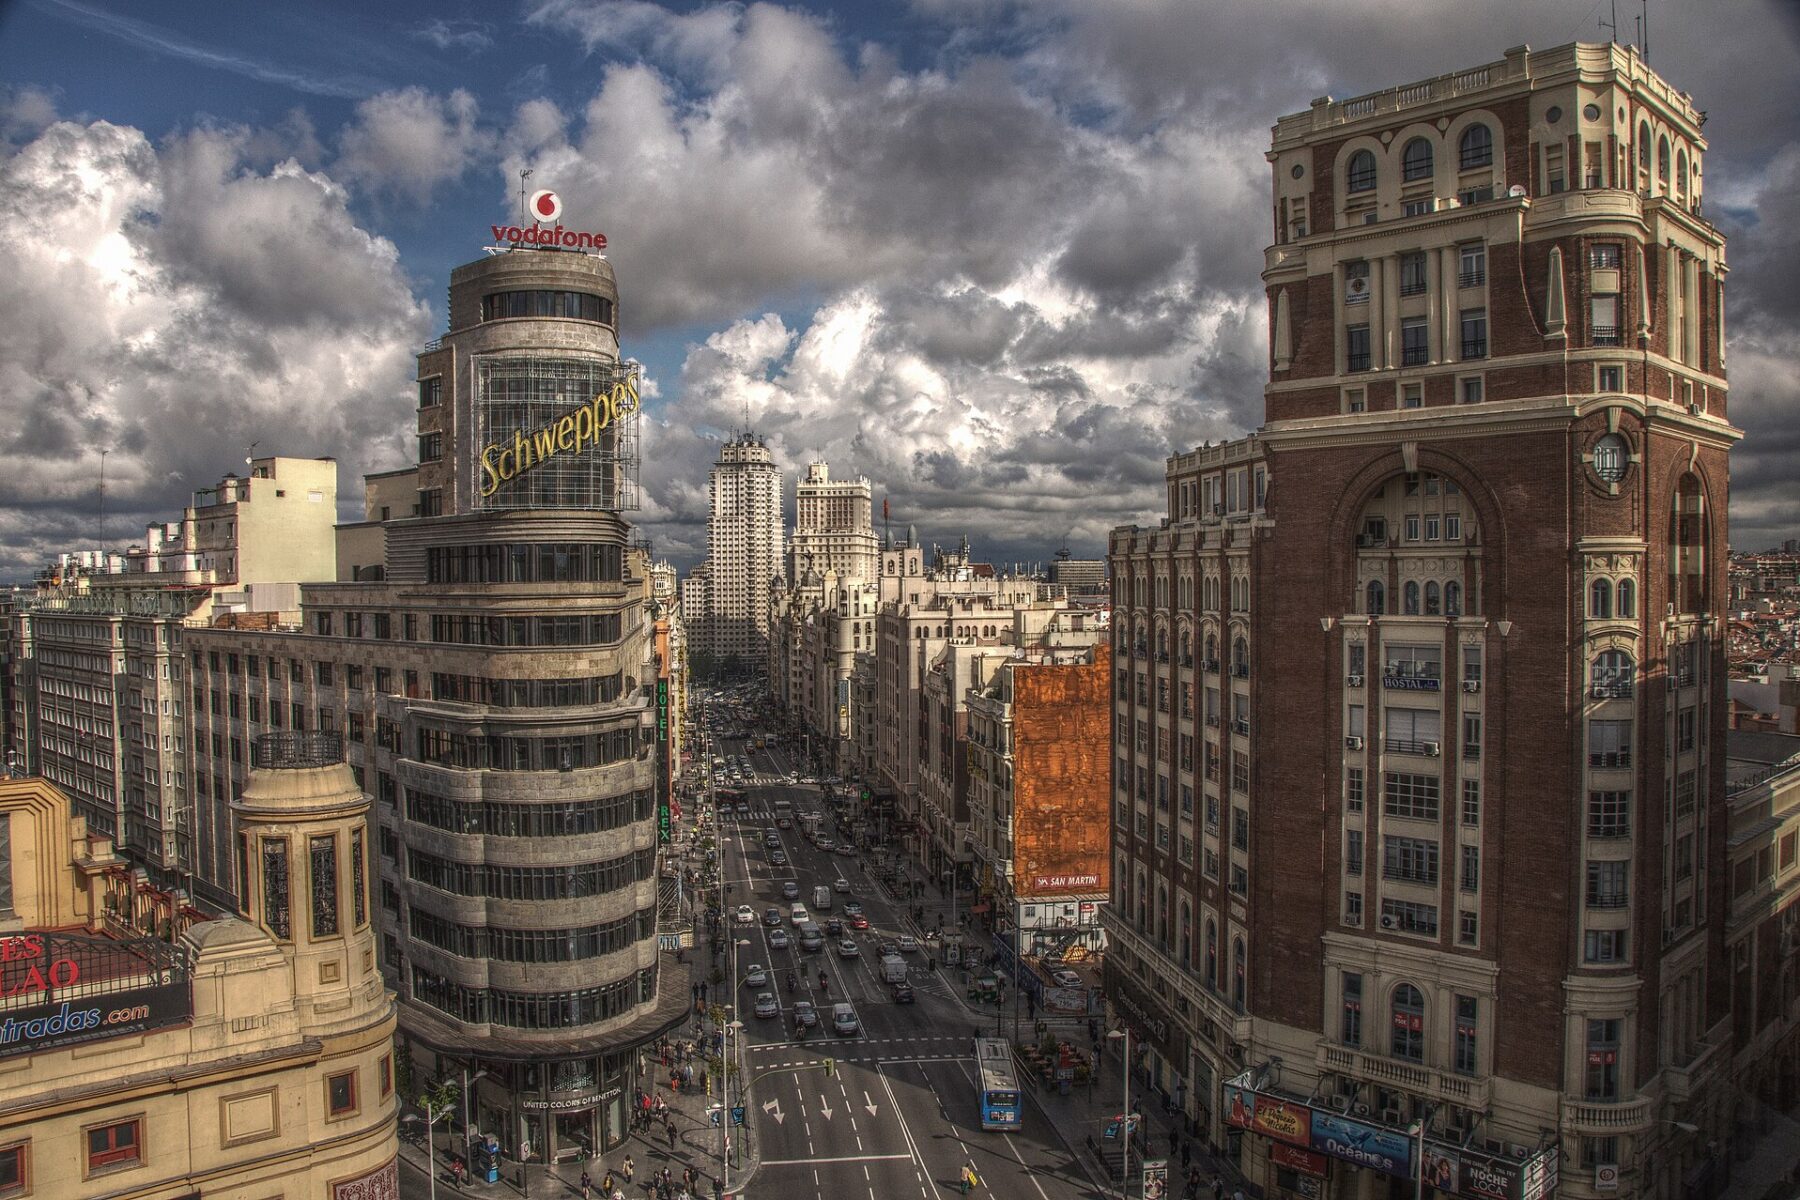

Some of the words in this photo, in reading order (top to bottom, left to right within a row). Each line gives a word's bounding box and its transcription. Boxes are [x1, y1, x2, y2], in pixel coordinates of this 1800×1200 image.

[491, 224, 608, 250] vodafone
[480, 372, 640, 497] Schweppes
[1384, 678, 1423, 689] HOSTAL
[658, 682, 668, 741] HOTEL
[660, 806, 670, 840] REX
[1050, 877, 1066, 886] SAN
[1067, 875, 1097, 885] MARTIN
[523, 1101, 549, 1109] UNITED
[550, 1099, 580, 1109] COLORS
[581, 1097, 591, 1105] OF
[591, 1087, 622, 1103] BENETTON
[1257, 1104, 1267, 1116] El
[1470, 1168, 1508, 1187] NOCHE
[1473, 1179, 1504, 1195] LOCA
